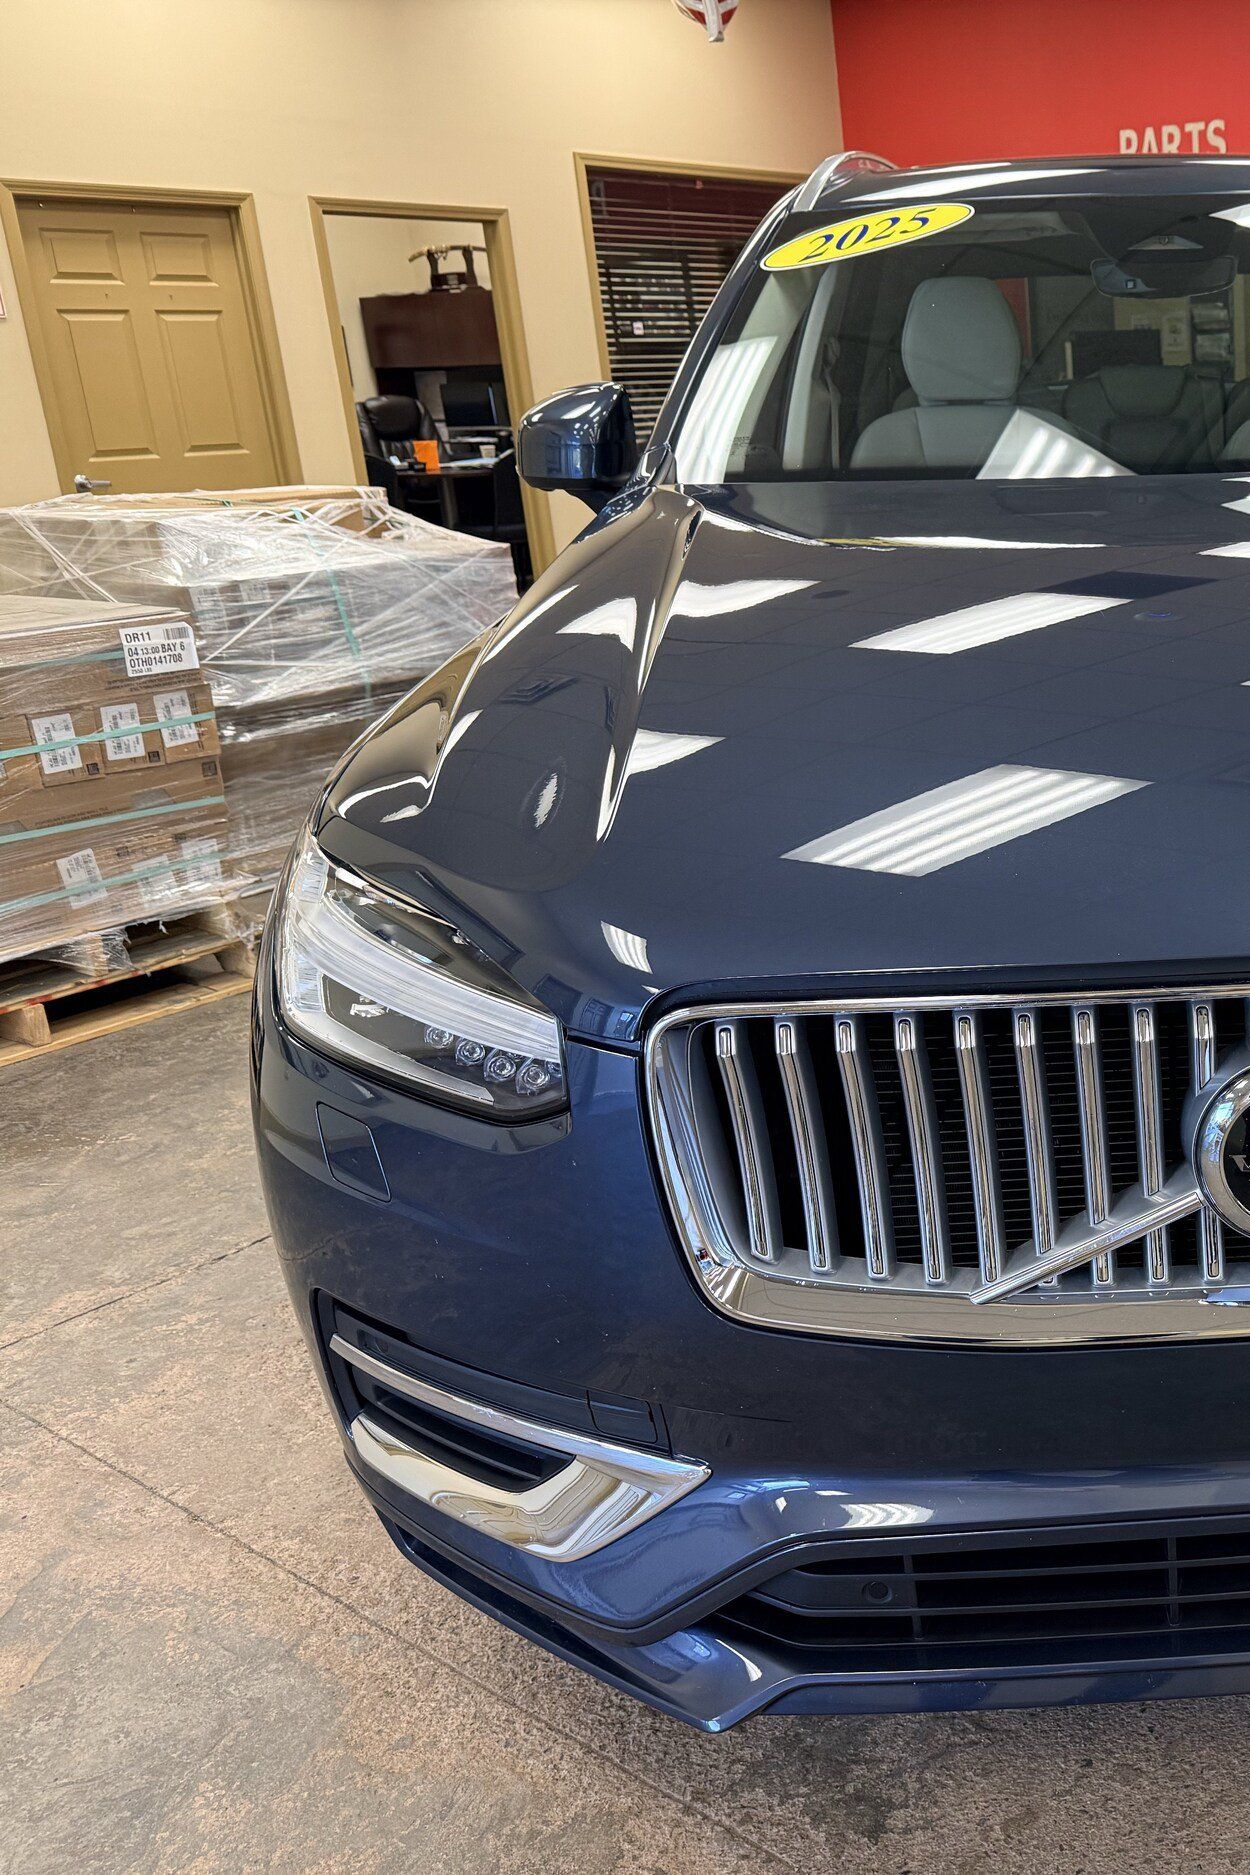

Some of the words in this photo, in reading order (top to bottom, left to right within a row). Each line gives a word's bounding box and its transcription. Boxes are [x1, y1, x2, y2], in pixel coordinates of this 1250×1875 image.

[1119, 119, 1227, 155] PARTS
[798, 208, 937, 262] 2025
[125, 631, 151, 643] DR11
[127, 647, 139, 657] 04
[140, 646, 160, 655] 13:00
[161, 643, 177, 653] BAY
[179, 641, 186, 651] 6
